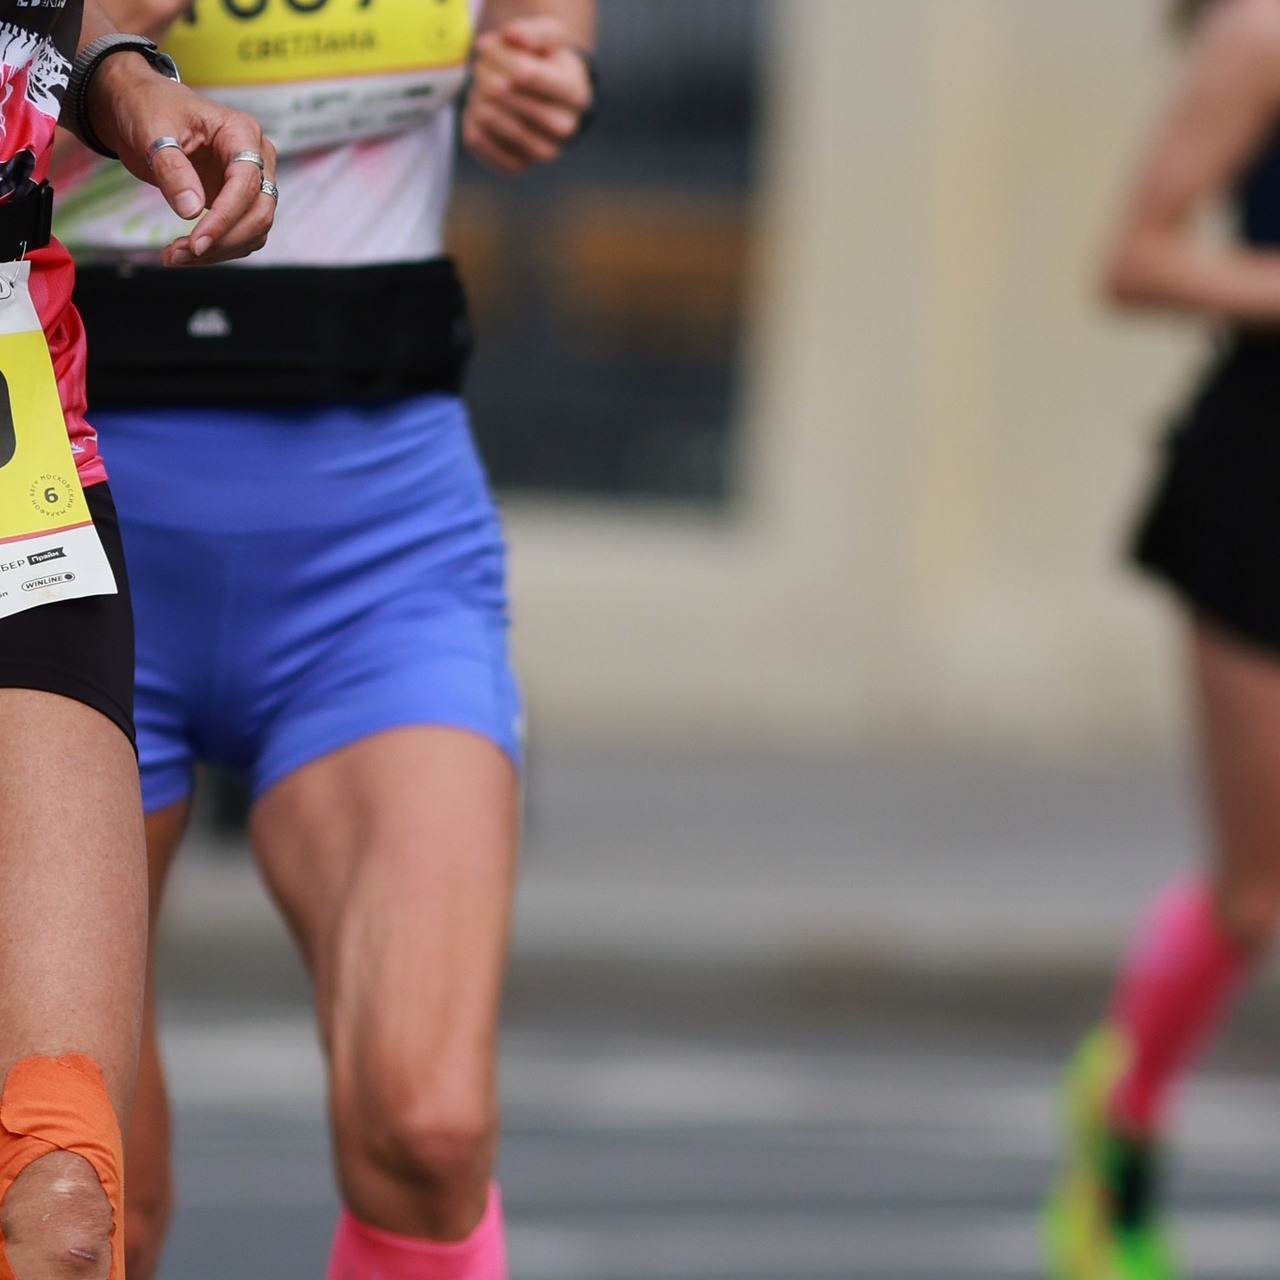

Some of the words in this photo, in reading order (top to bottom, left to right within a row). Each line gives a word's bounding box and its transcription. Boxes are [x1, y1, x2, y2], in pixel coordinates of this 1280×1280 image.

[44, 487, 59, 503] 6
[31, 549, 60, 564] Прайм
[25, 575, 64, 590] WINLINE
